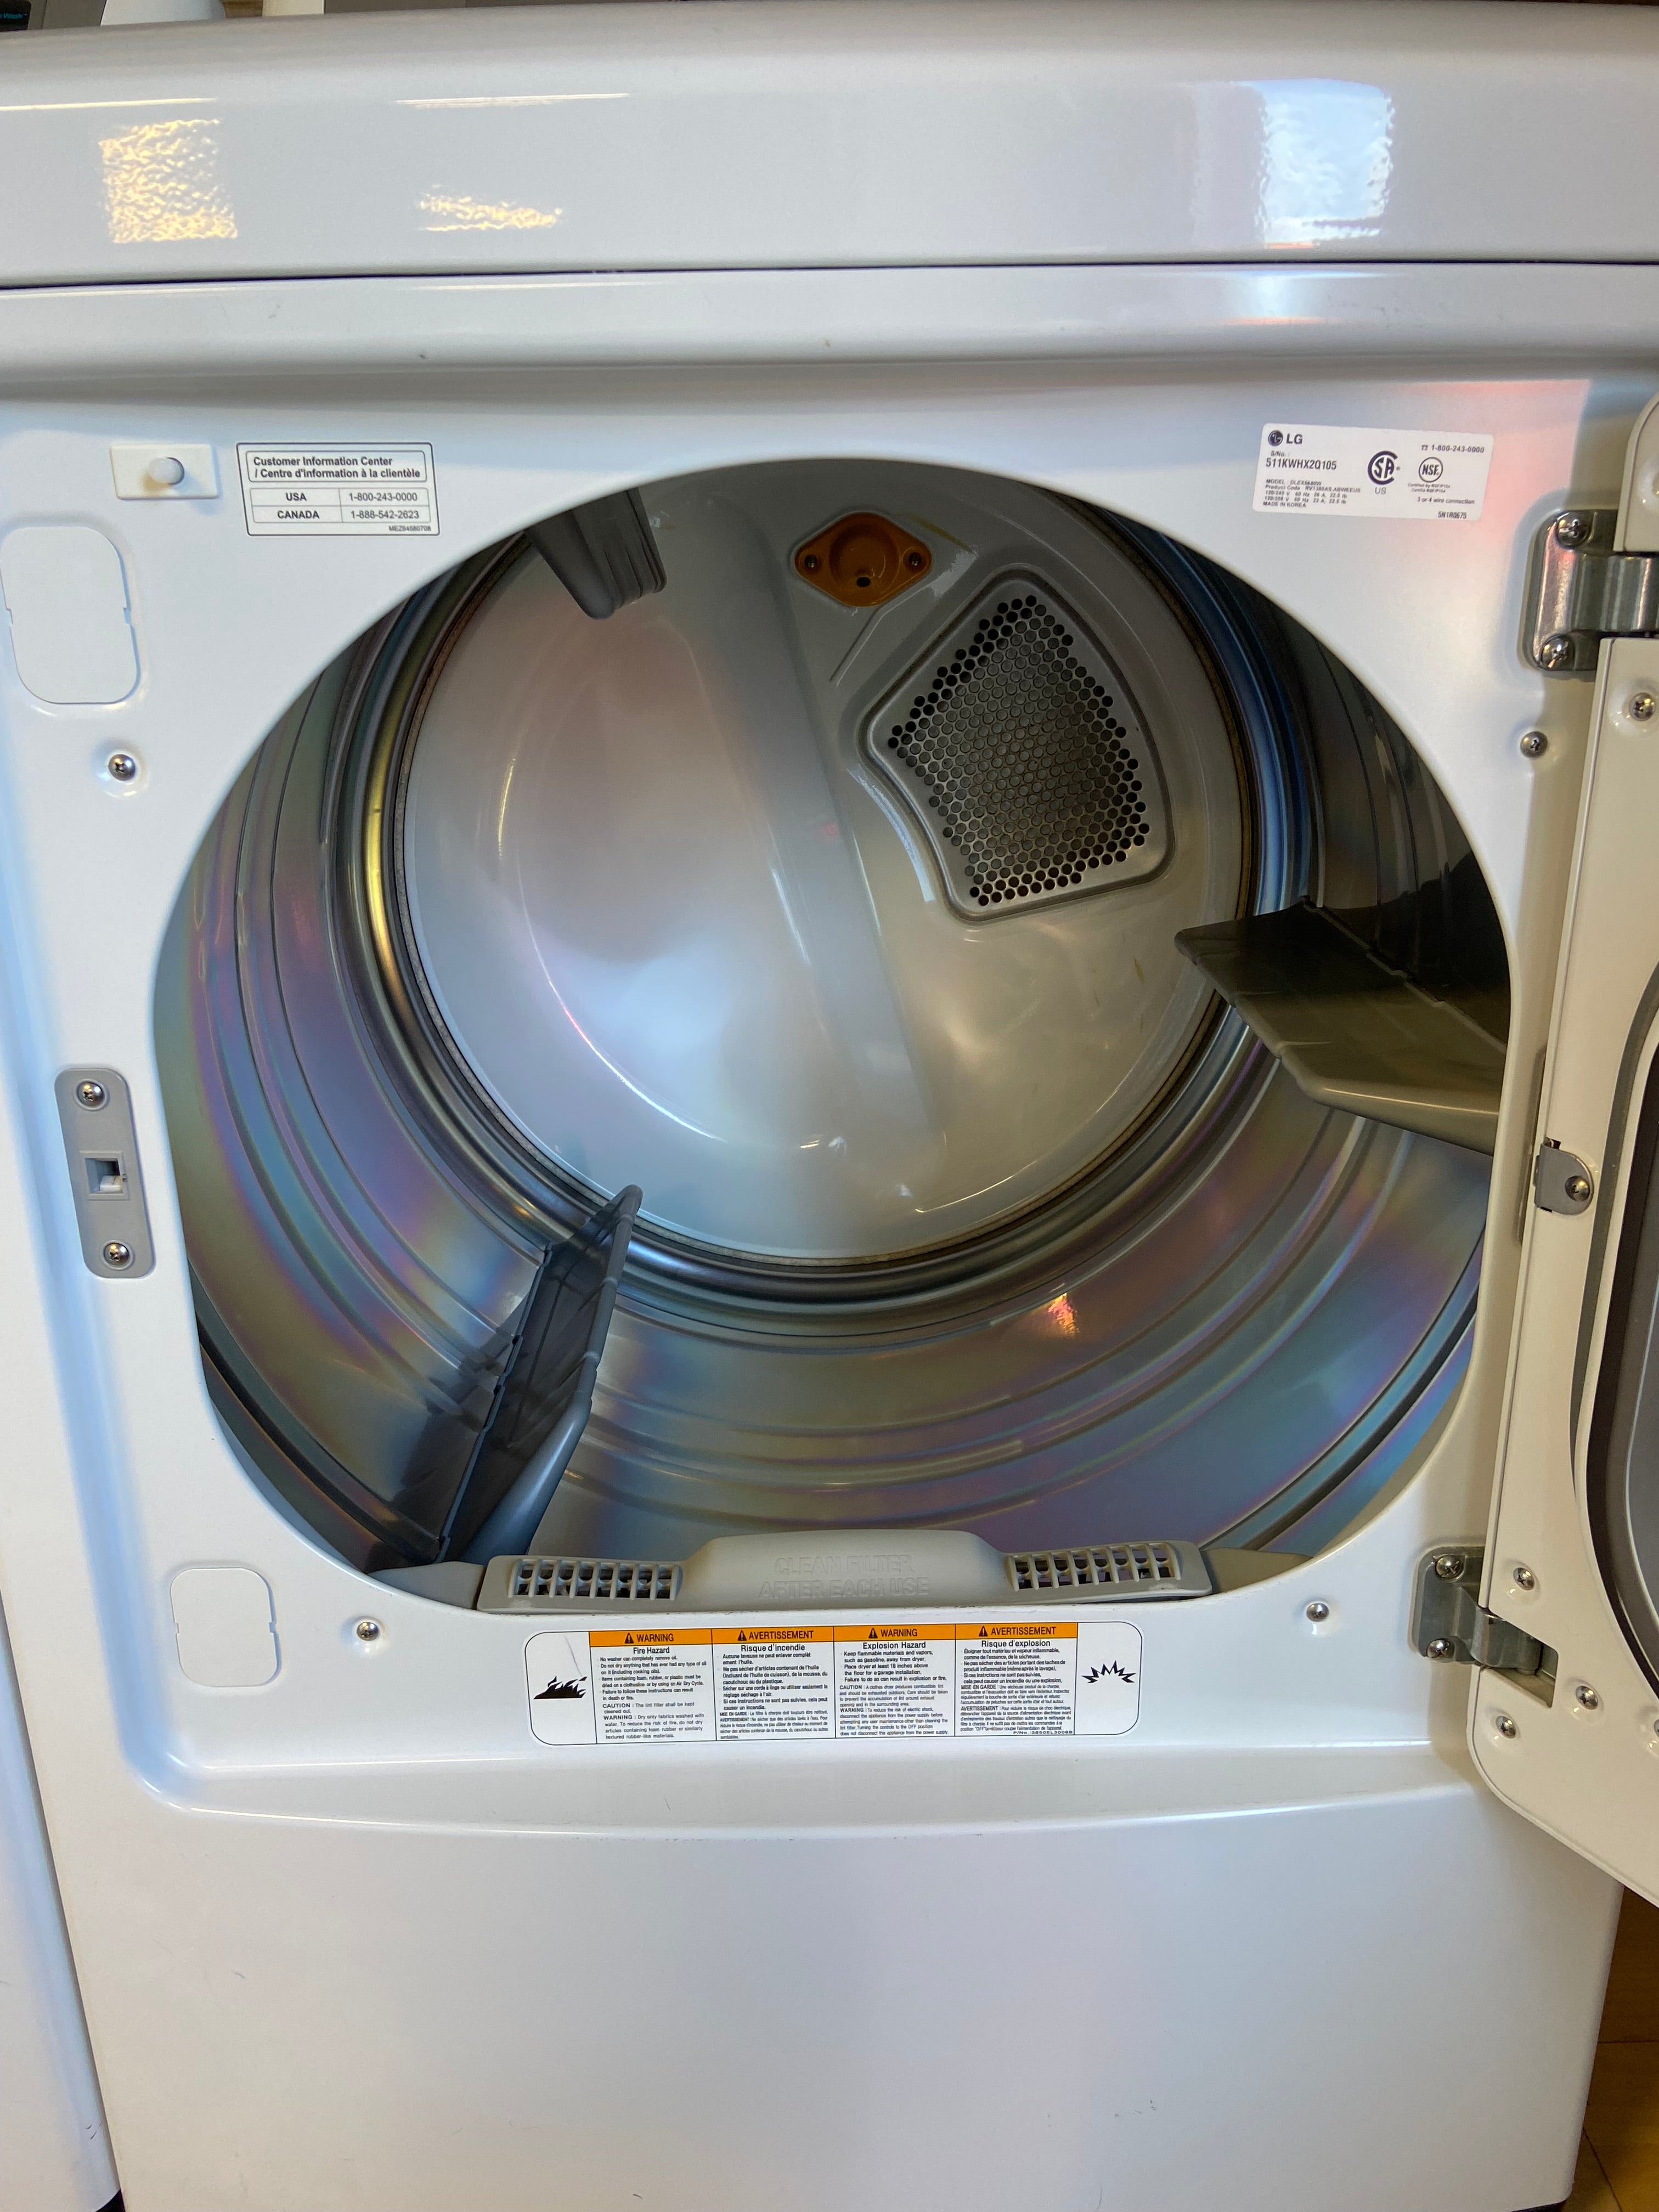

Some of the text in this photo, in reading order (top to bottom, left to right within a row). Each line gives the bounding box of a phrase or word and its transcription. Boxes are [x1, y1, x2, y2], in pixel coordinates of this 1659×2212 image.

[1286, 433, 1303, 444] LG
[1431, 444, 1485, 453] 1-800-243-0000
[253, 456, 392, 466] Customer Information Center
[1266, 458, 1337, 470] 511KWHX2Q105
[261, 469, 292, 478] Centre
[295, 469, 358, 478] d'information
[361, 469, 367, 478] à
[369, 469, 378, 478] la
[381, 469, 420, 478] clientèle
[286, 493, 306, 501] USA
[349, 493, 417, 501] 1-800-243-0000
[277, 511, 319, 519] CANADA
[351, 511, 419, 519] 1-888-542-2623
[775, 1555, 915, 1575] CLEAN FILTER
[759, 1577, 930, 1599] AFTER EACH USE
[749, 1630, 814, 1640] AVERTISSEMENT
[881, 1628, 917, 1637] WARNING
[991, 1627, 1056, 1635] AVERTISSEMENT
[636, 1633, 674, 1642] WARNING
